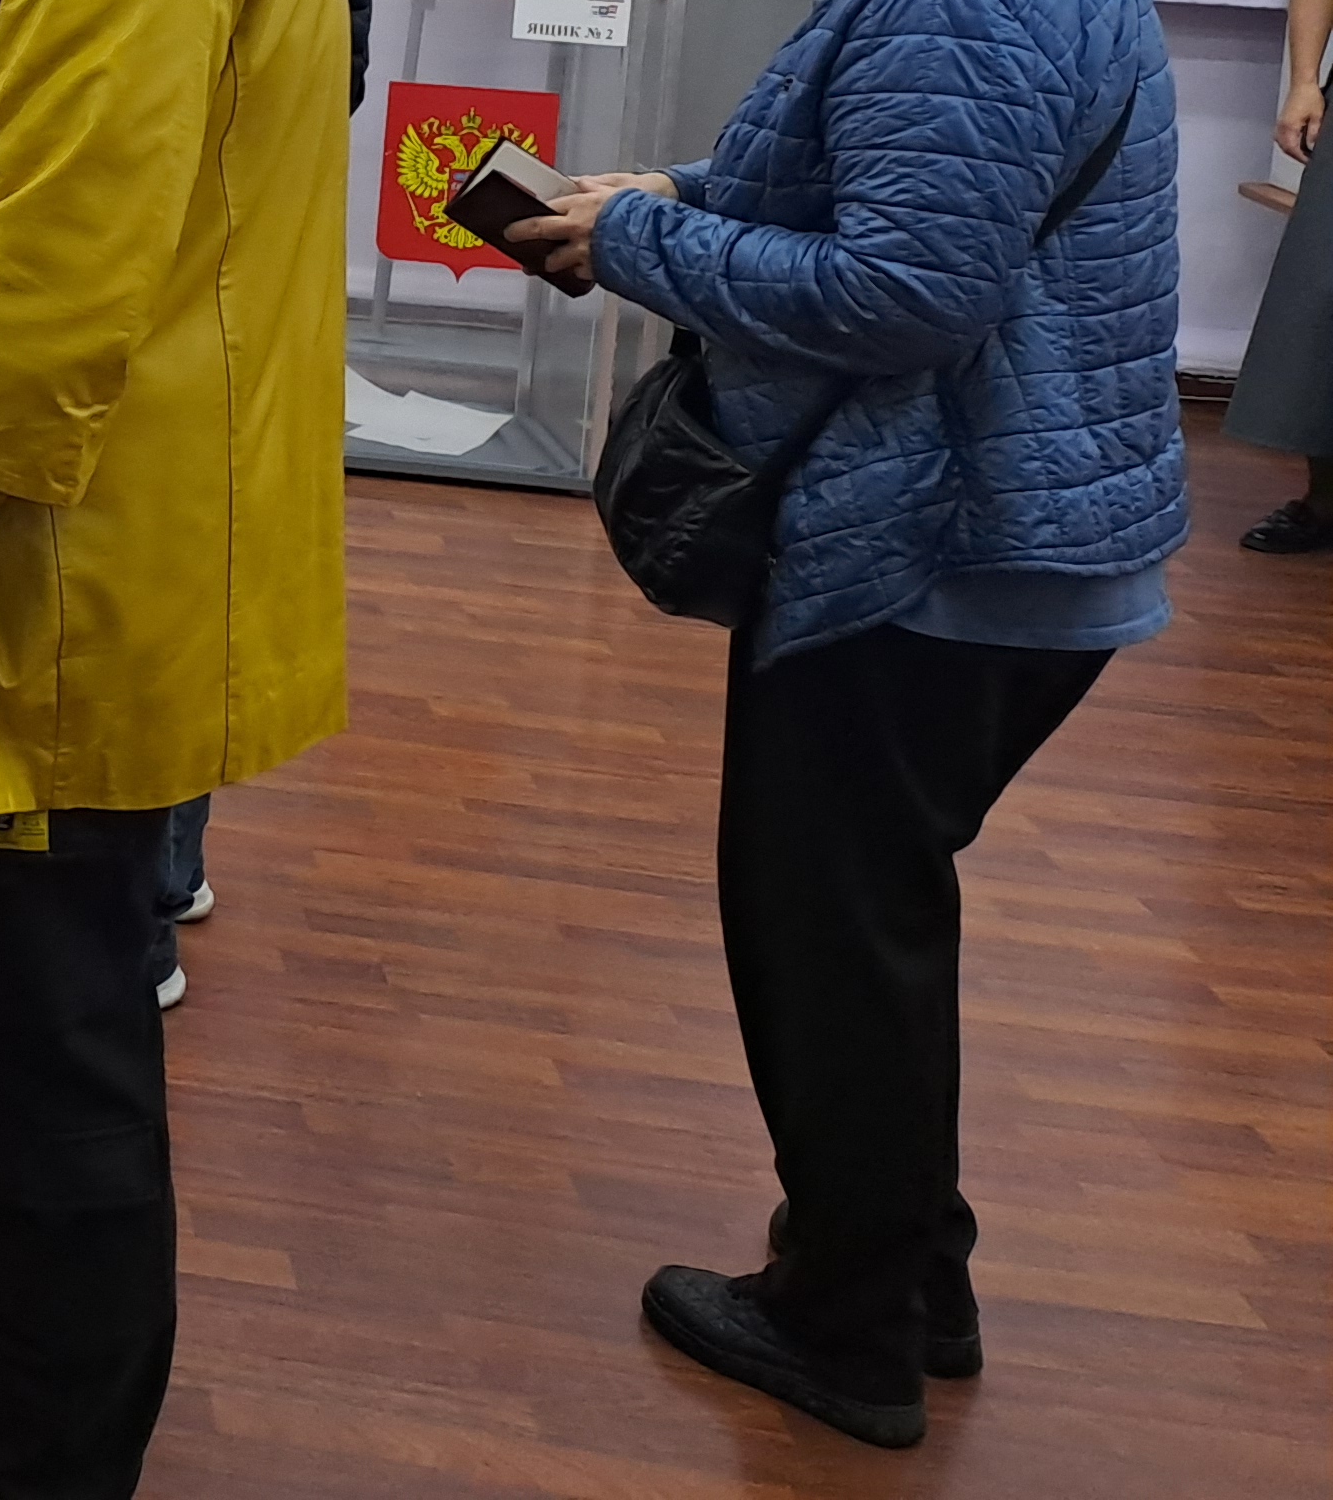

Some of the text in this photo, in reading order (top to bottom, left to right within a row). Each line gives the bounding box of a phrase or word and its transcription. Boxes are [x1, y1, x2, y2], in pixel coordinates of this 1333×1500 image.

[527, 23, 613, 40] ЯЩИК № 2
